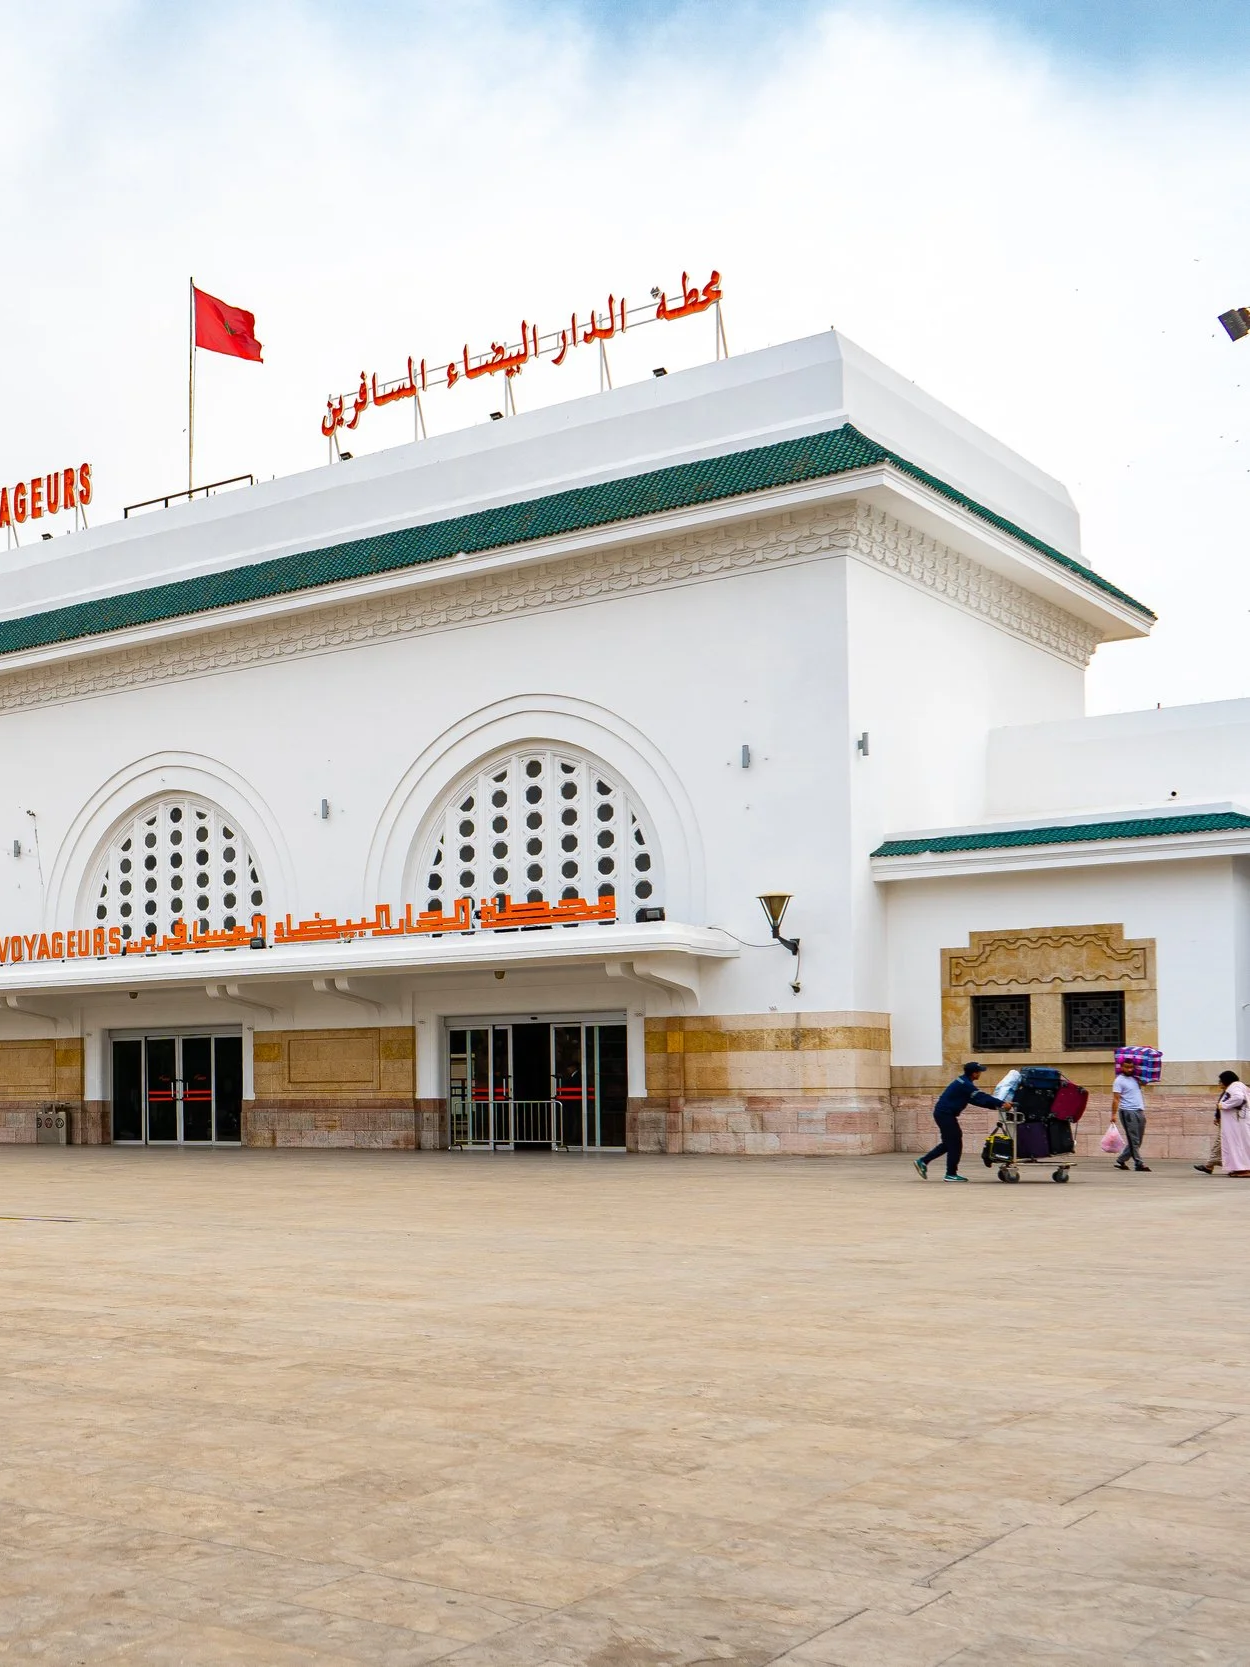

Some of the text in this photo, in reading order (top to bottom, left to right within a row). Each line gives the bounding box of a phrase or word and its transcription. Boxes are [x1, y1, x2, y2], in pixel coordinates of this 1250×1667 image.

[321, 270, 723, 437] محطة الدار البيضاء المسافرين
[372, 898, 471, 937] الدار
[480, 894, 617, 929] محطة
[126, 914, 267, 954] المسافرين
